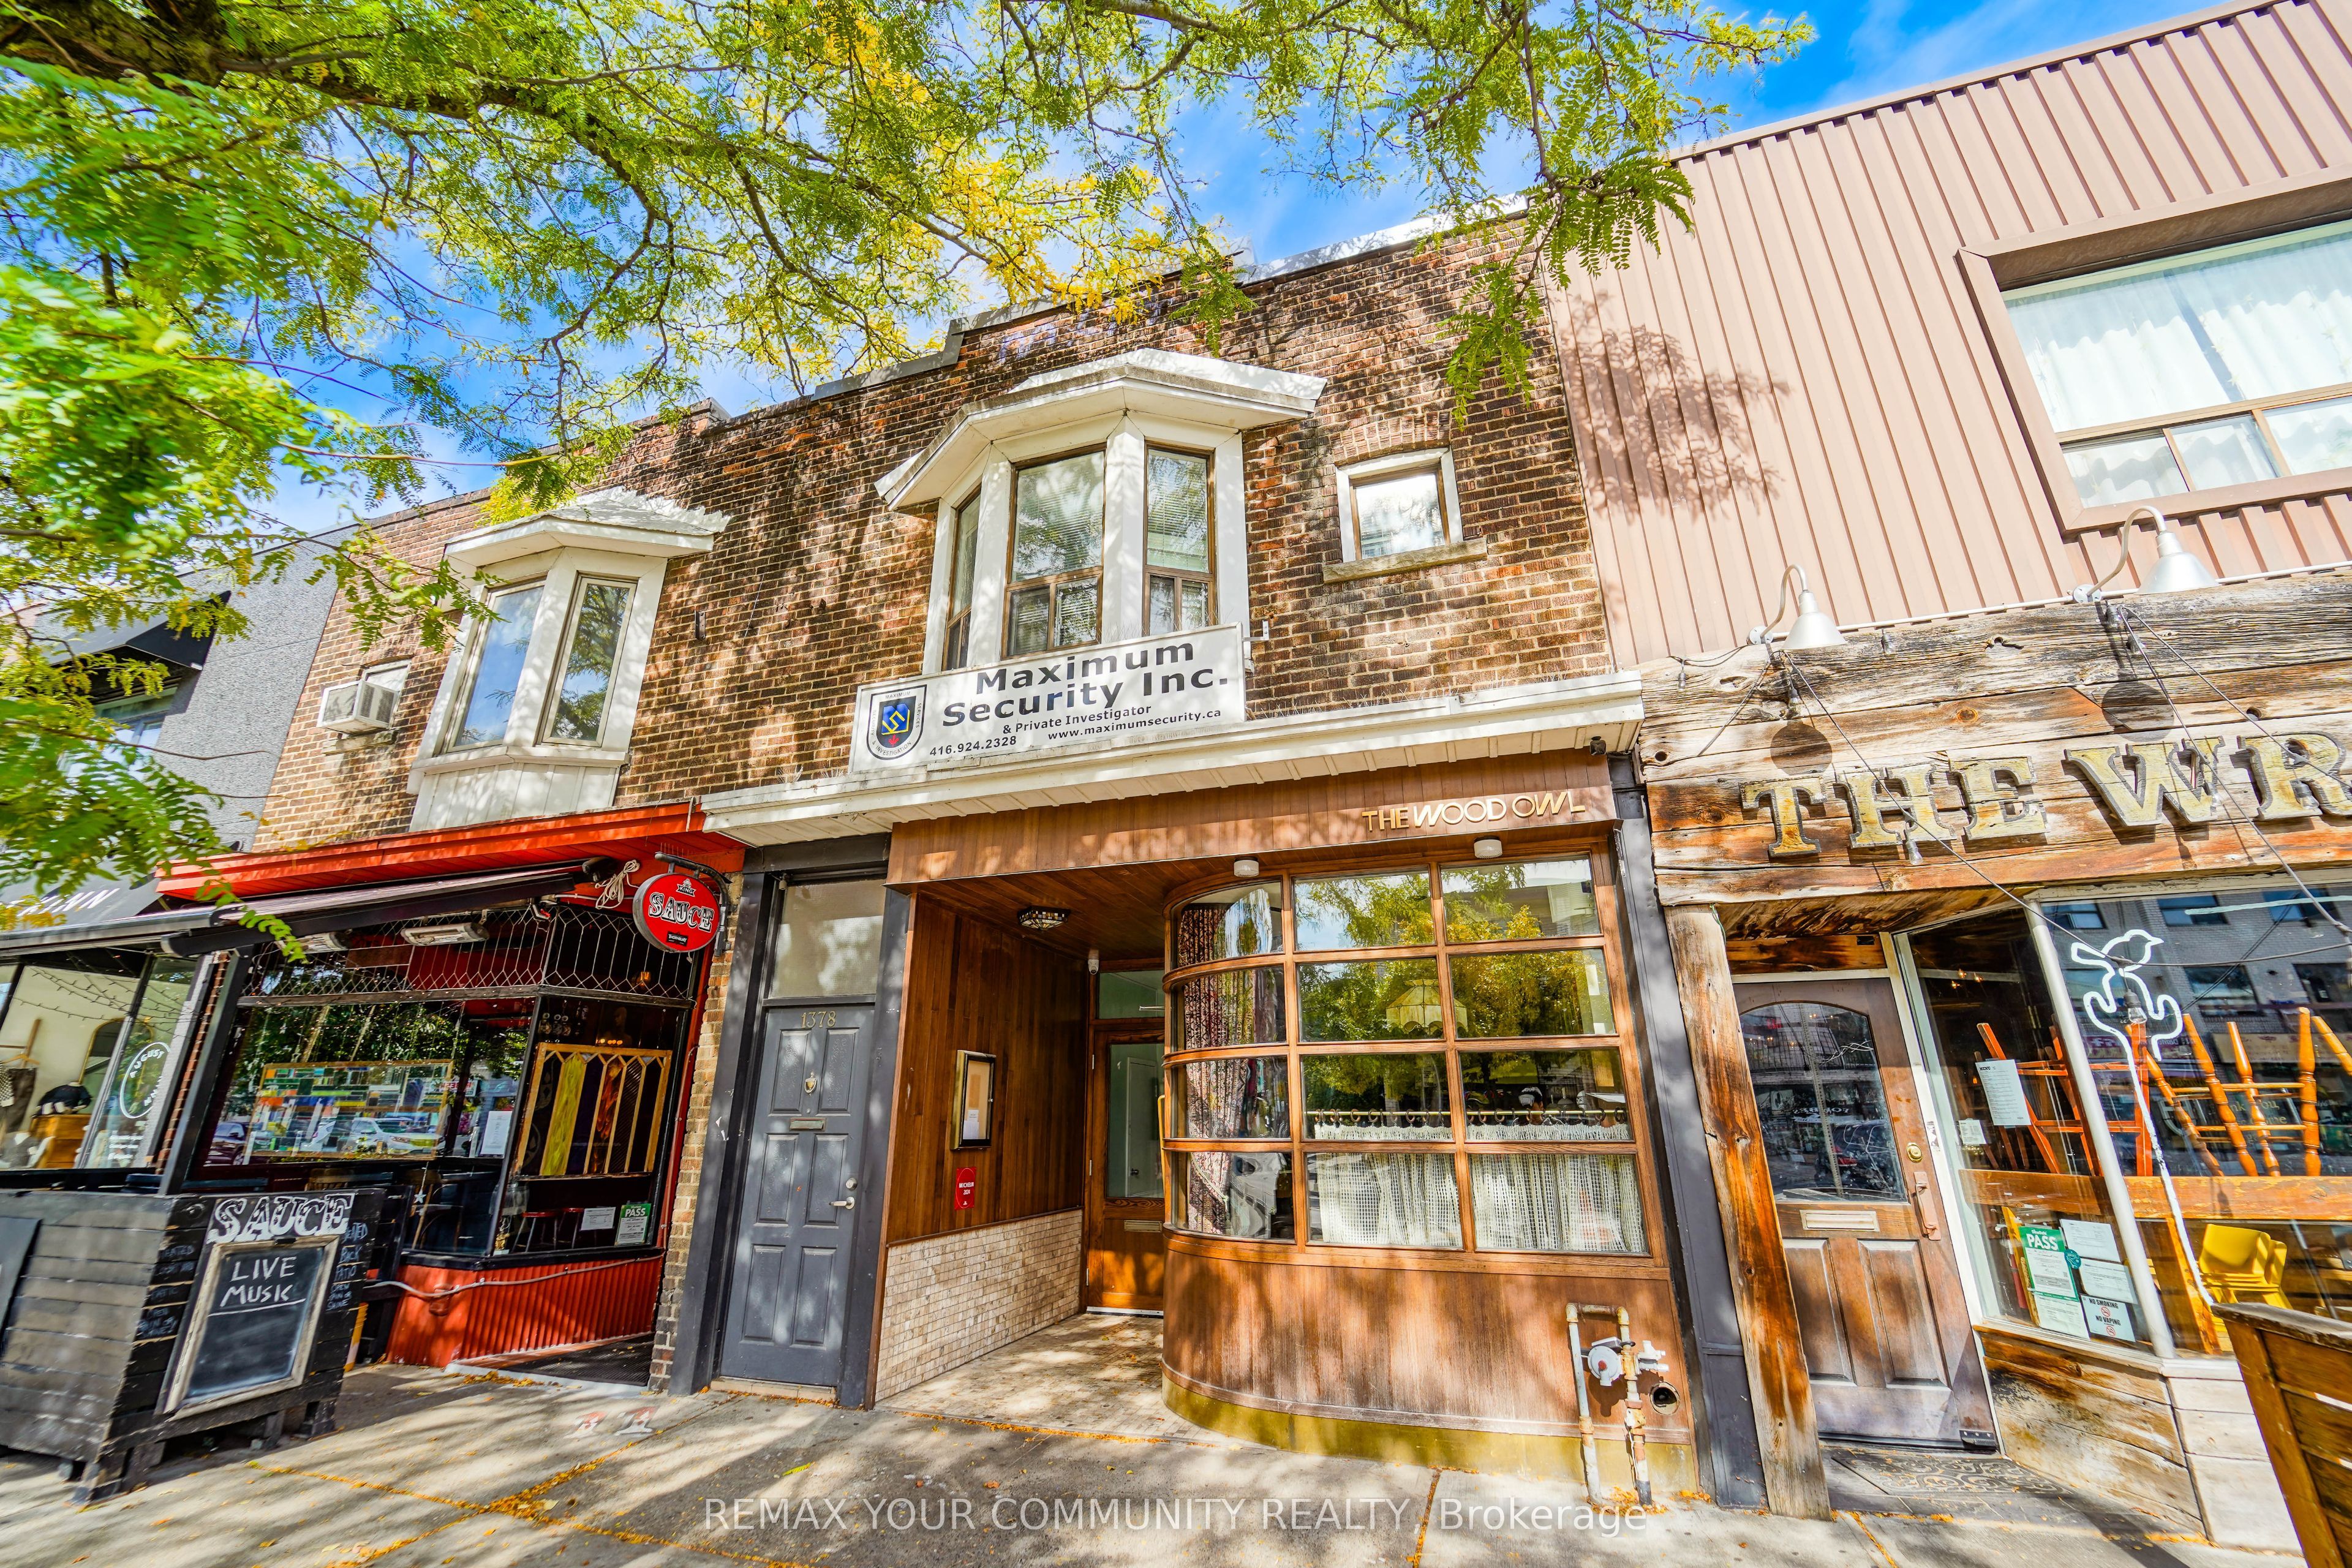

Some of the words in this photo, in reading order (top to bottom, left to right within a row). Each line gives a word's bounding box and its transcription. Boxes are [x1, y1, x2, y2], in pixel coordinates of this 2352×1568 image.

[976, 643, 1193, 695] Maximum
[943, 682, 1123, 726] Security
[1144, 669, 1227, 696] Inc.
[1003, 725, 1011, 734] &
[1016, 718, 1061, 733] Private
[1066, 705, 1152, 725] Investigator
[1049, 710, 1221, 740] www.maximumsecurity.ca
[875, 741, 911, 755] INVESTIGATION
[930, 736, 1017, 756] 416.924.2328
[1740, 755, 2048, 858] THE
[2064, 731, 2352, 827] WR
[1362, 807, 1409, 831] THE
[1413, 798, 1507, 827] WOOD
[1512, 791, 1586, 817] OWL
[648, 892, 715, 933] SAUCE
[801, 1011, 836, 1028] 1378
[206, 1193, 355, 1244] SAUCE
[625, 1207, 646, 1218] PASS
[2026, 1233, 2059, 1251] PASS
[230, 1256, 297, 1282] LIVE
[220, 1284, 293, 1308] MUSIC
[2096, 1299, 2119, 1309] SMOKING
[2103, 1317, 2121, 1326] VAPING
